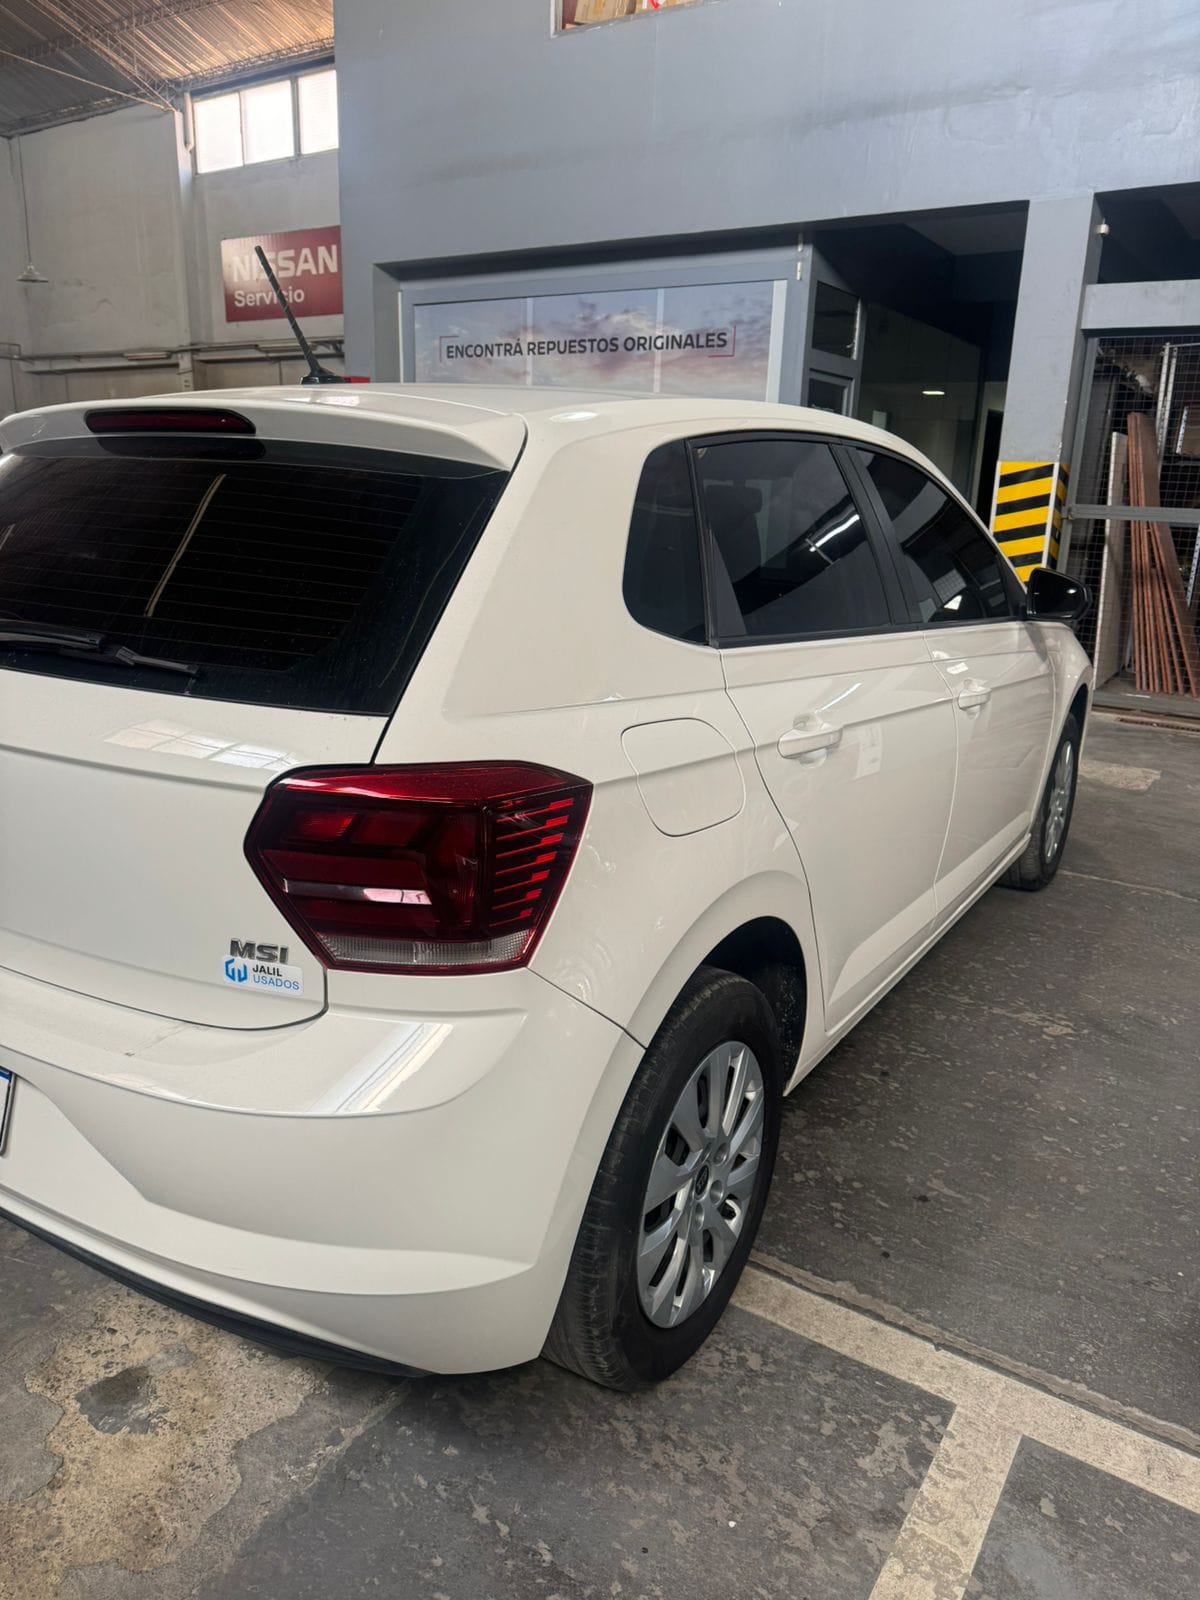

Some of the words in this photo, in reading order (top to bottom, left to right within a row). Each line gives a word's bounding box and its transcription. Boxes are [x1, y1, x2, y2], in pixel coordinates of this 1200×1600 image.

[446, 338, 523, 359] ENCONTRÁ
[527, 337, 619, 356] REPUESTOS
[623, 332, 728, 352] ORIGINALES
[230, 938, 289, 965] MSI
[252, 964, 283, 977] JALIL
[253, 974, 300, 991] USADOS
